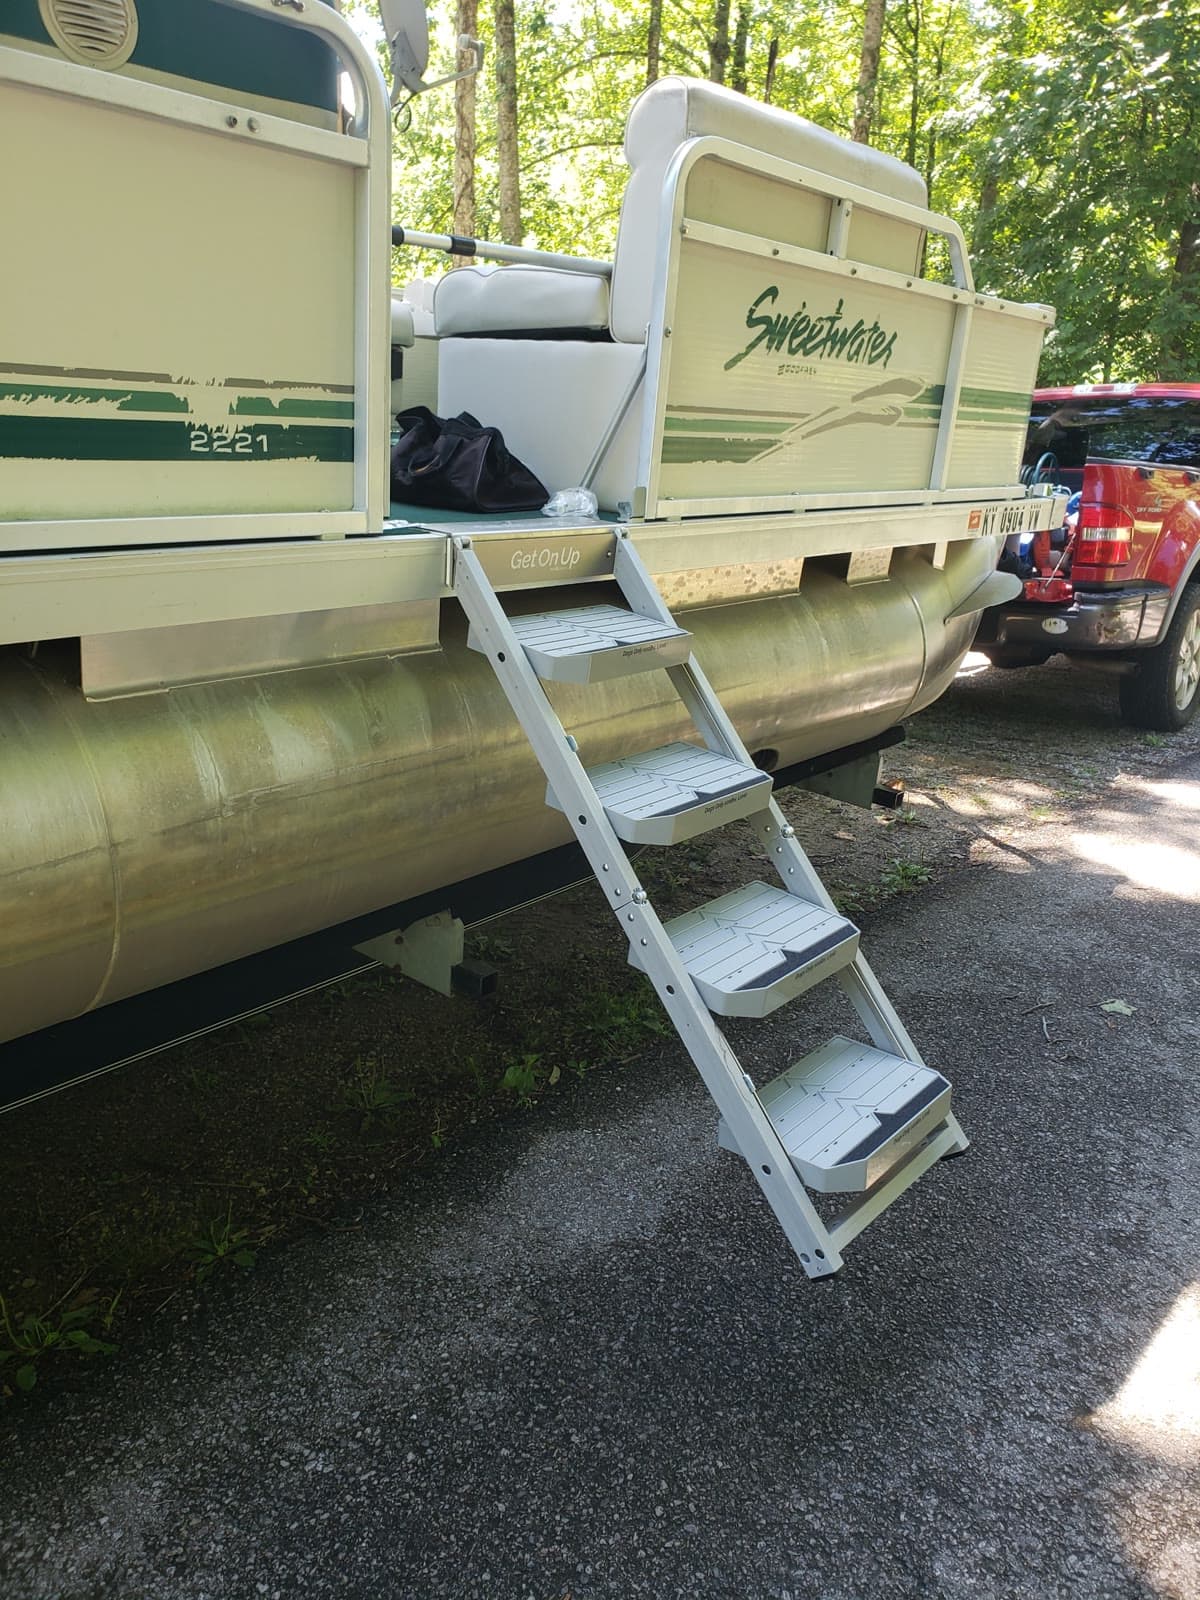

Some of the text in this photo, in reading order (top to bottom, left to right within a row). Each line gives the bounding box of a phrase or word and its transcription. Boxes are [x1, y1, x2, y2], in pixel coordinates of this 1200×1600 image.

[190, 430, 269, 453] 2221
[1000, 504, 1026, 534] 0904
[511, 546, 580, 569] Get On Up
